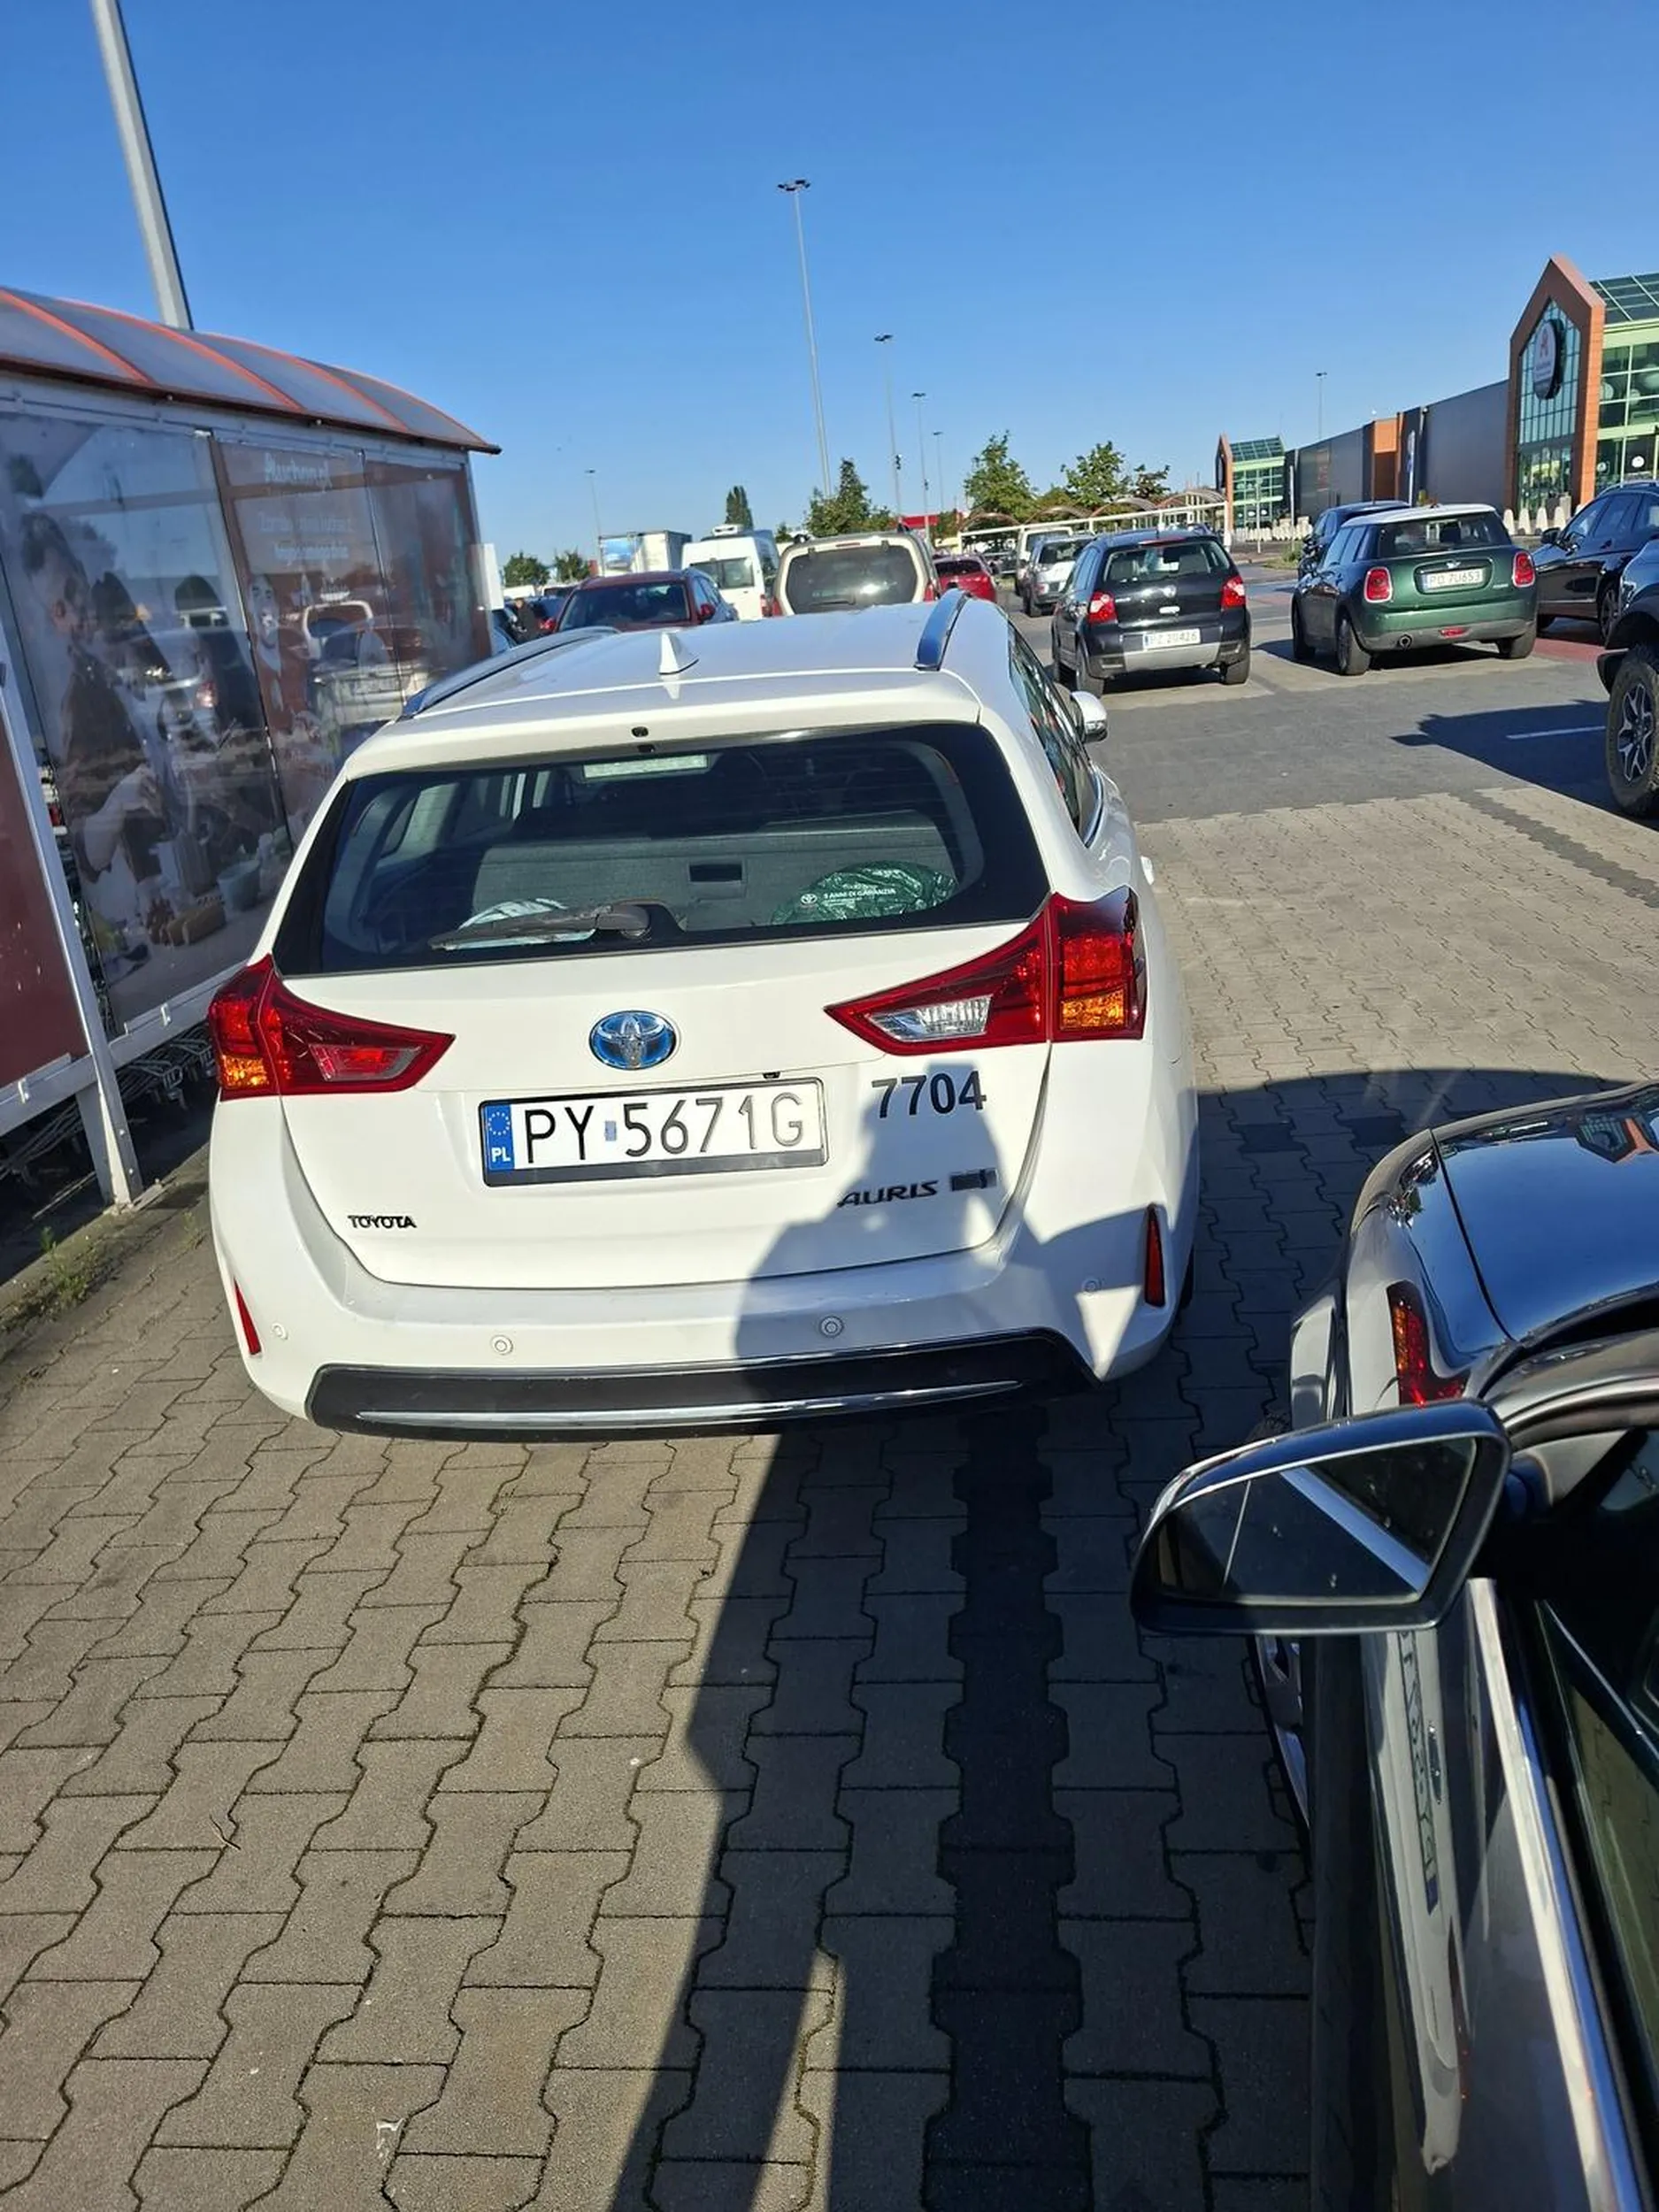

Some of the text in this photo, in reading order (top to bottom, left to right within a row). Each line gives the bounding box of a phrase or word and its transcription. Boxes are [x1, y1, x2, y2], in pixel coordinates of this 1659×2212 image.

[872, 1070, 987, 1118] 7704
[524, 1092, 803, 1164] PY 5671G
[491, 1147, 511, 1163] PL
[836, 1179, 940, 1209] AURIS
[347, 1215, 418, 1228] TOYOTA
